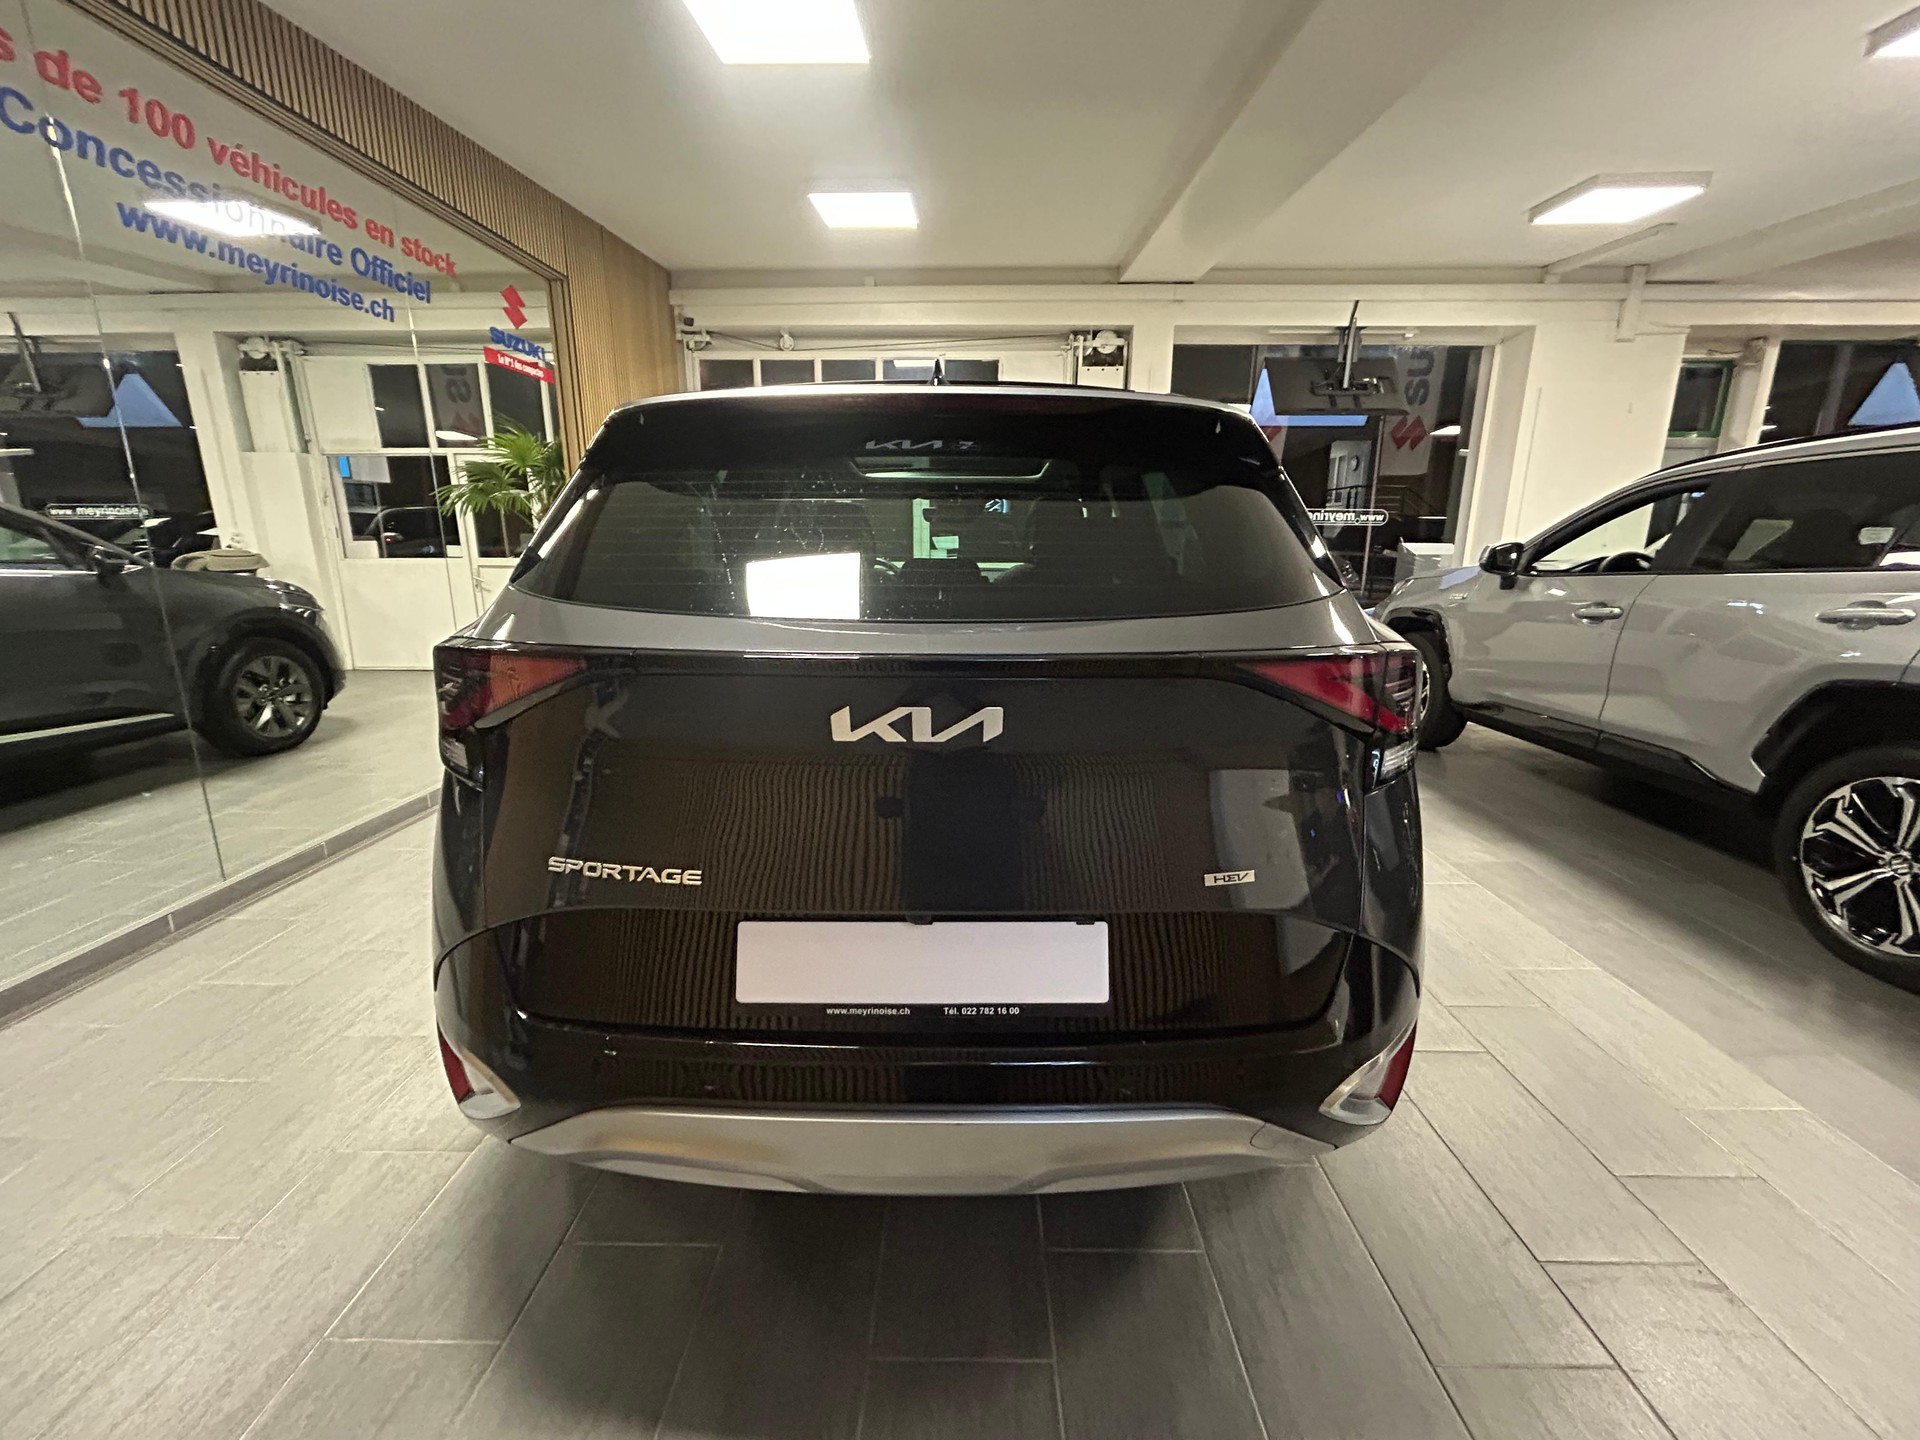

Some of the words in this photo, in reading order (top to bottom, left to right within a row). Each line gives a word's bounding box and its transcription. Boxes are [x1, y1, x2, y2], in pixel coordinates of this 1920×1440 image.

[34, 50, 103, 104] de
[119, 87, 196, 150] 100
[207, 137, 358, 230] véhicules
[364, 218, 395, 248] en
[400, 236, 457, 277] stock
[116, 201, 395, 322] www.meyrinoise.ch
[350, 246, 431, 303] Officiel
[489, 326, 546, 363] SUZUKI
[548, 856, 703, 886] SPORTAGE
[1213, 872, 1249, 884] HEV
[826, 1007, 911, 1017] www.meyrinoise.ch
[943, 1006, 959, 1016] Tél.
[961, 1006, 978, 1016] 022
[979, 1006, 995, 1016] 782
[997, 1006, 1008, 1016] 16
[1008, 1006, 1020, 1016] 00
